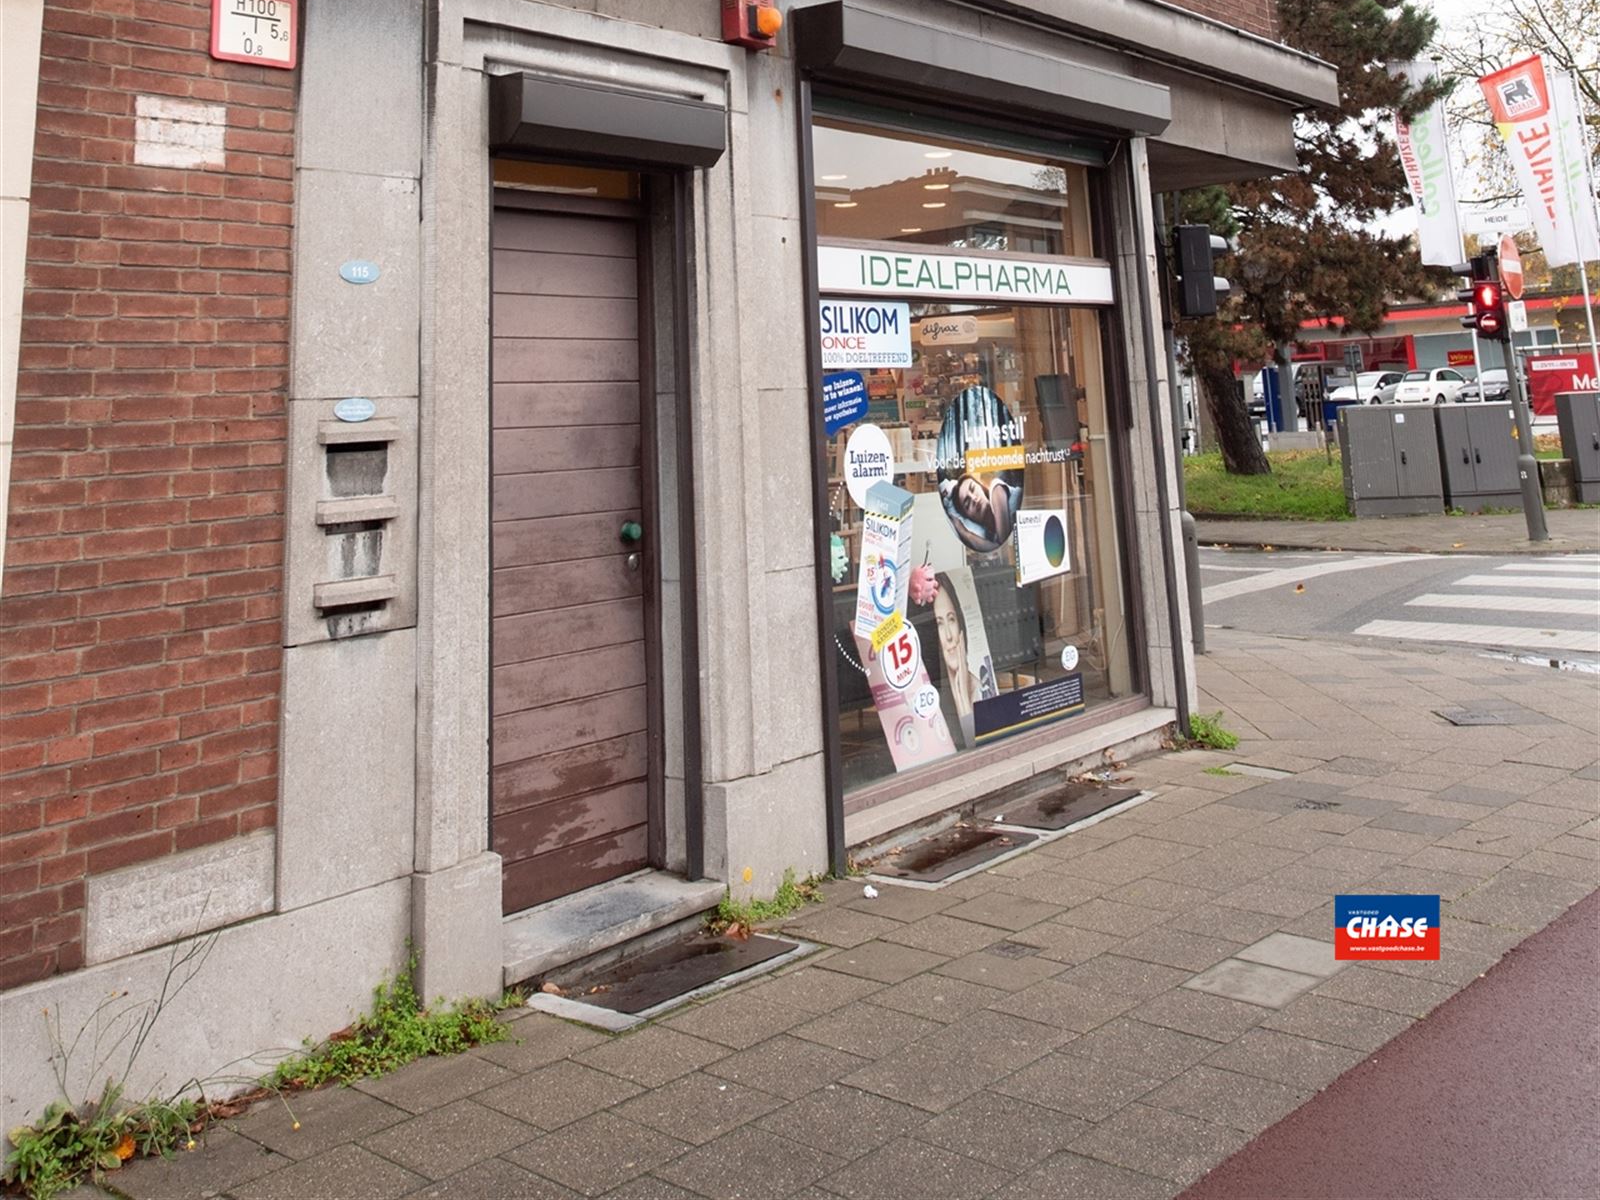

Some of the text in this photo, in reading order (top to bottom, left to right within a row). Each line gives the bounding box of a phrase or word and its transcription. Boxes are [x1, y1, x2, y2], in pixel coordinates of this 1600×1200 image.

[351, 266, 369, 278] 115
[860, 254, 1072, 296] IDEALPHARMA
[821, 305, 899, 335] SILIKOM
[821, 336, 866, 350] ONCE
[823, 352, 909, 364] 100% DOELTREFFEND
[849, 449, 890, 464] Luizen-
[952, 451, 965, 469] de
[967, 449, 1025, 471] gedroomde
[852, 463, 889, 478] alarm!
[865, 517, 897, 541] SILIKOM
[887, 633, 913, 670] 15
[919, 692, 935, 708] EG
